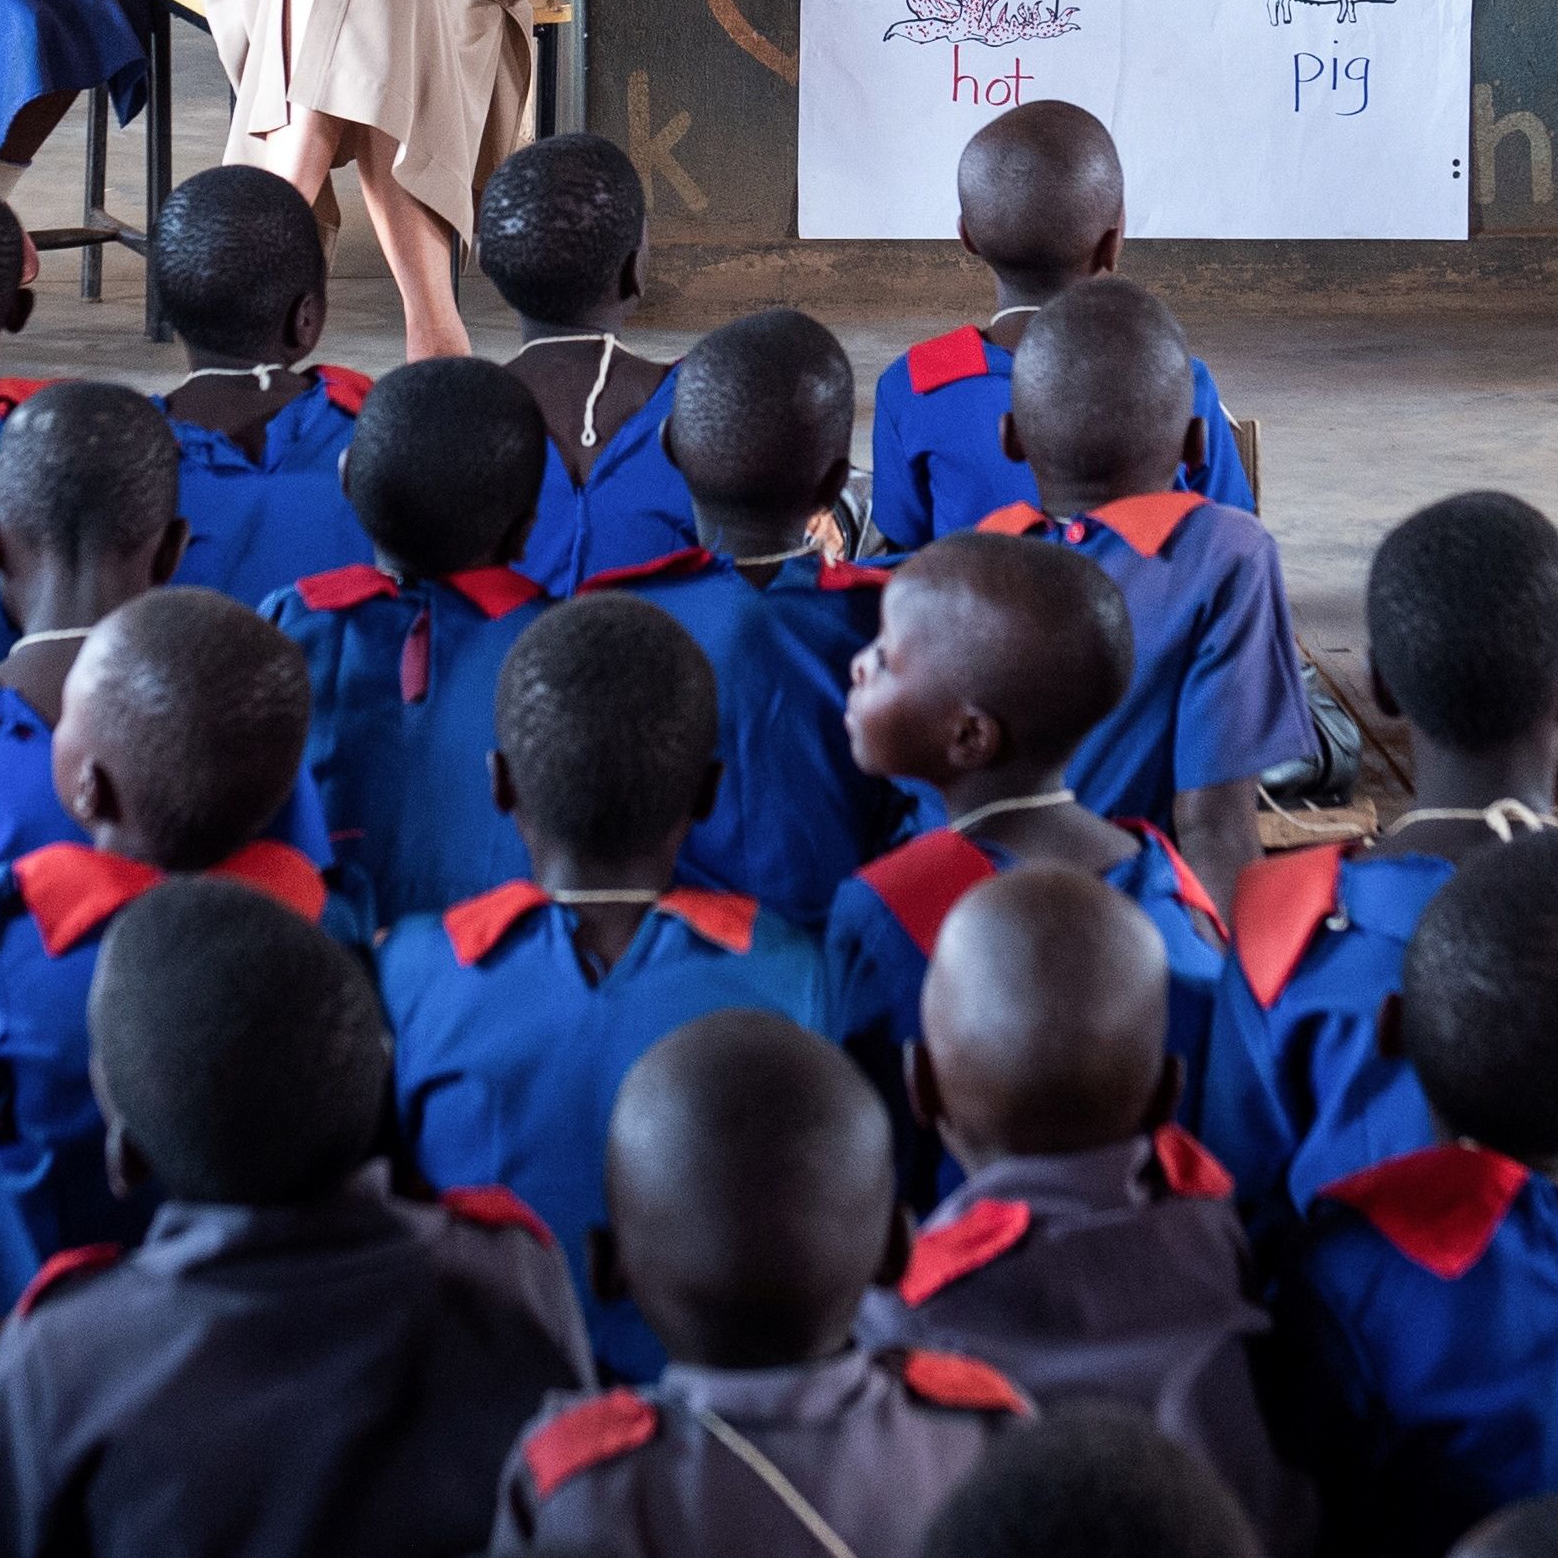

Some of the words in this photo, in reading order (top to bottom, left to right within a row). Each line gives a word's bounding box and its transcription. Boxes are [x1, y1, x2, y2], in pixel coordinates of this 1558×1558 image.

[951, 43, 1035, 107] hot
[1292, 39, 1371, 117] pig
[1473, 82, 1554, 205] h
